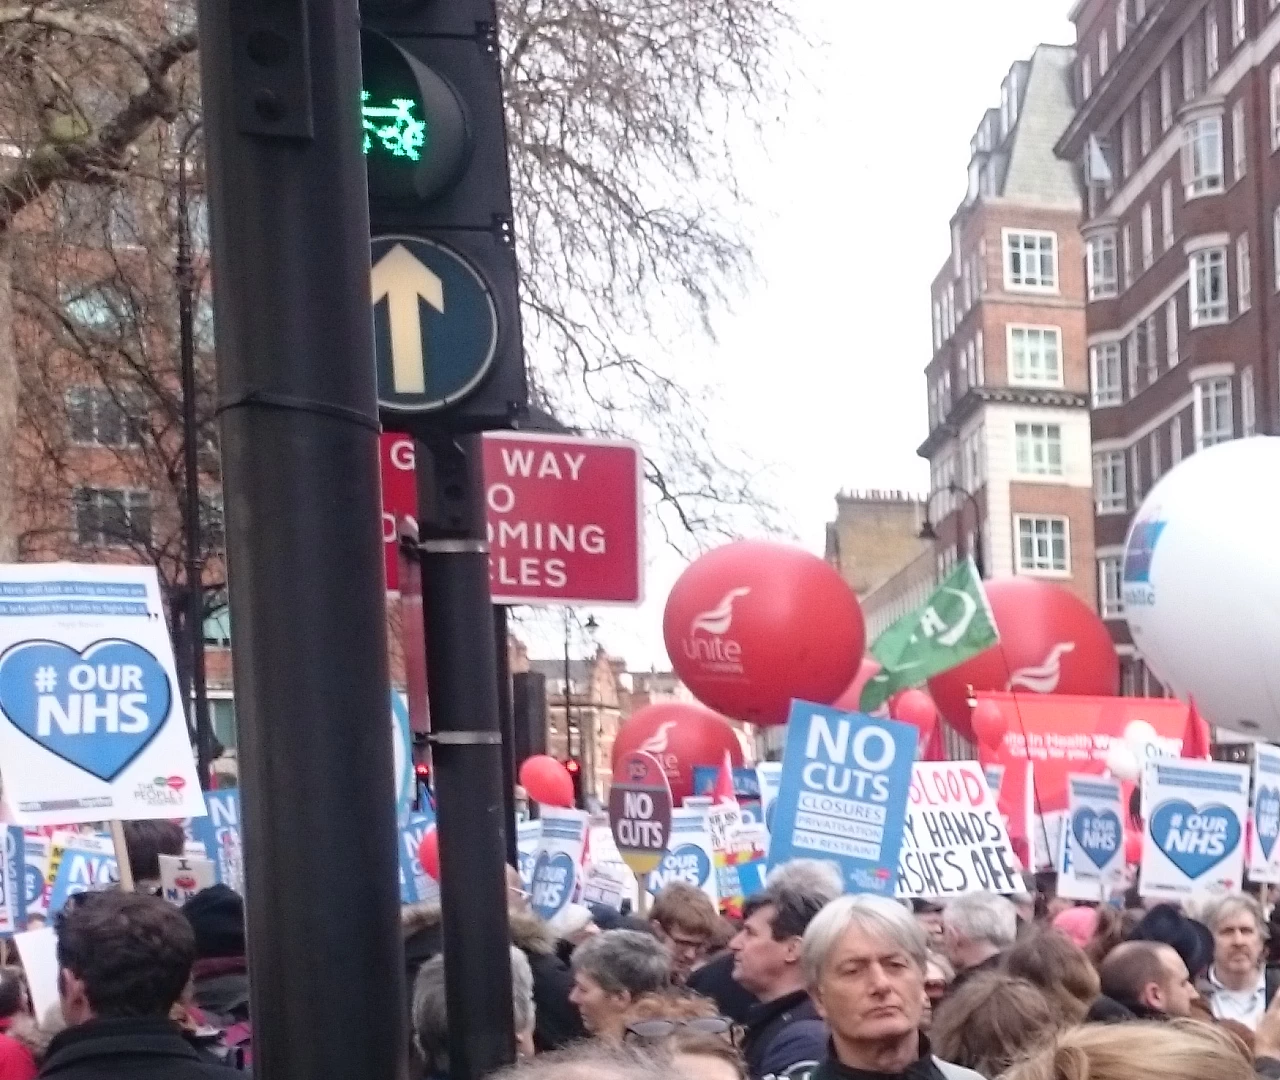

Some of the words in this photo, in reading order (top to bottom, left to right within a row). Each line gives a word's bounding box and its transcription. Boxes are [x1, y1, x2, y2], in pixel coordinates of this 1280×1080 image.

[502, 448, 587, 480] WAY
[35, 665, 58, 692] #
[68, 664, 144, 692] OUR
[37, 692, 150, 736] NHS
[804, 712, 896, 773] NO
[802, 761, 890, 802] CUTS
[623, 792, 655, 820] NO
[801, 796, 882, 822] CLOSURES
[617, 820, 663, 848] CUTS
[797, 814, 883, 839] PRIVATISATION
[922, 810, 1002, 848] HANDS
[1090, 817, 1116, 833] OUR
[1186, 813, 1228, 833] OUR
[794, 833, 817, 848] PAY
[819, 836, 877, 856] RESTRAINT
[1082, 831, 1116, 851] NHS
[1165, 828, 1227, 857] NHS
[664, 854, 700, 871] OUR
[971, 846, 1016, 890] OFF
